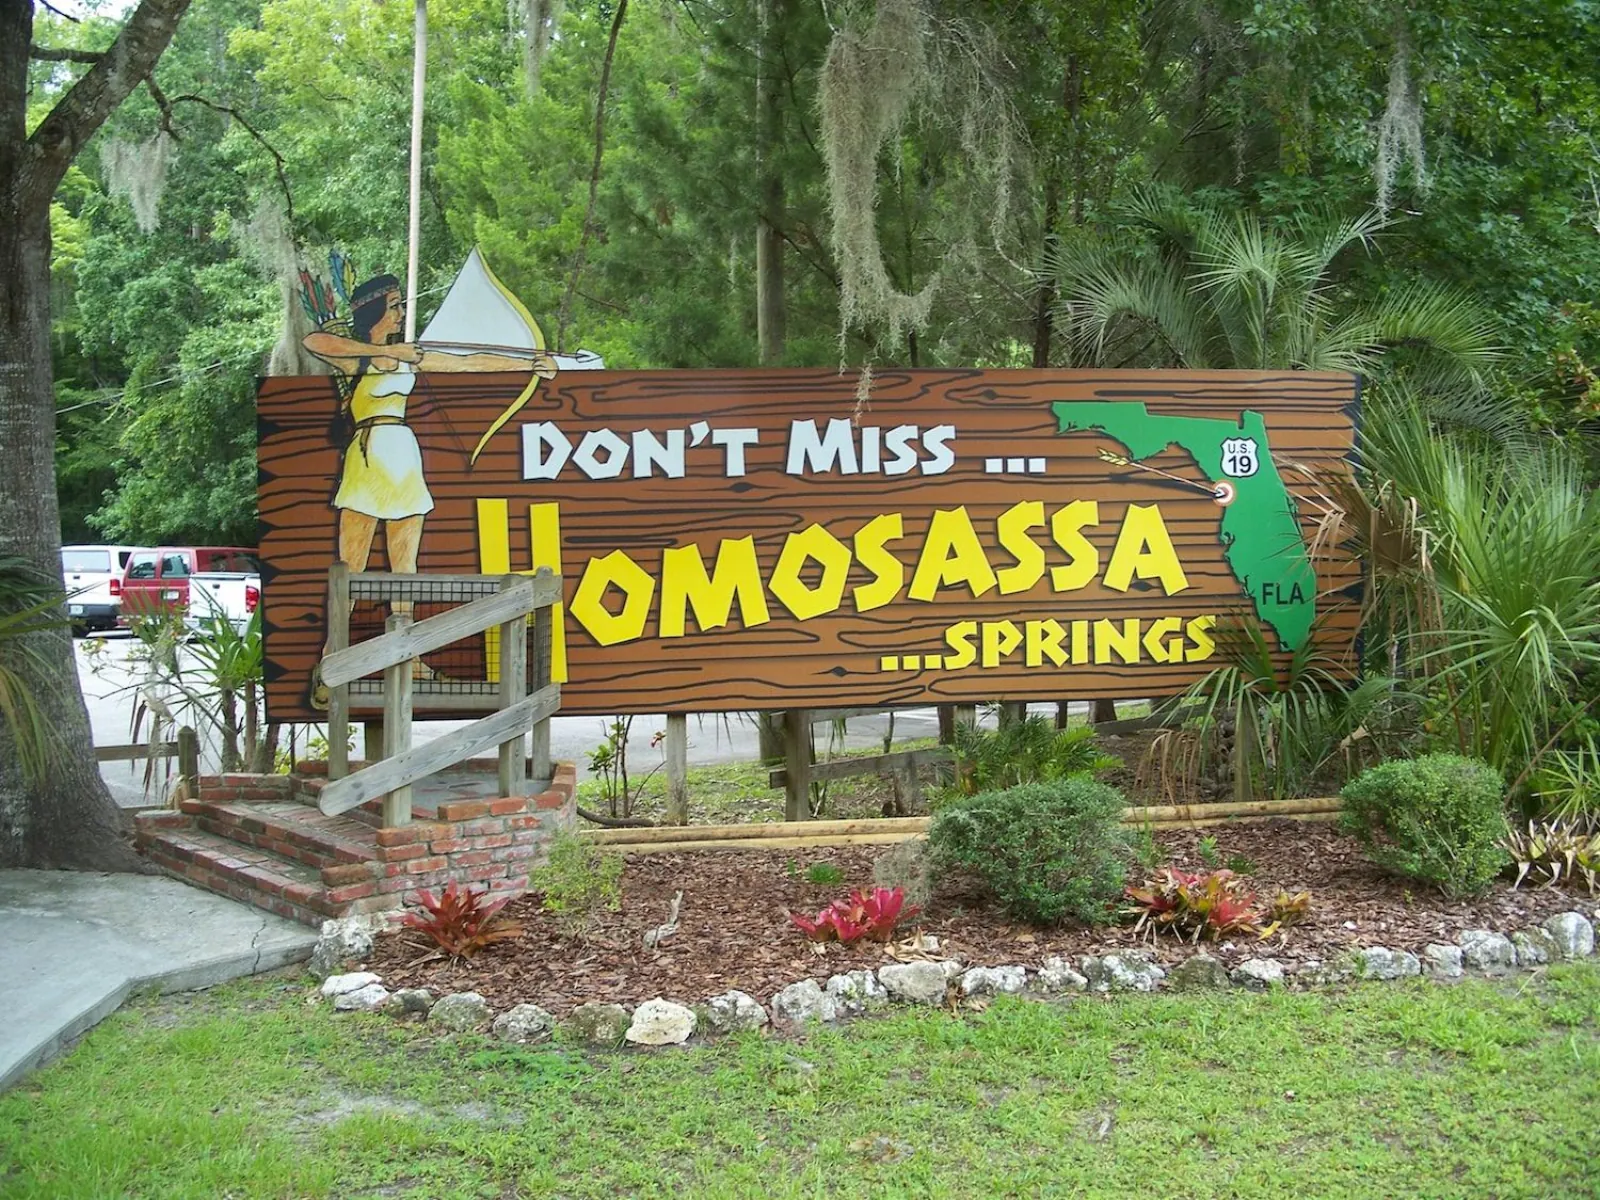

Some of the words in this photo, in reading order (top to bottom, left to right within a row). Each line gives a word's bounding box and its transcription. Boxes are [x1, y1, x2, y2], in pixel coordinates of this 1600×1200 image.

[521, 420, 759, 481] DON'T
[785, 417, 956, 476] MISS
[1228, 443, 1251, 454] U.S.
[1228, 455, 1251, 474] 19
[476, 497, 1189, 683] HOMOSASSA
[1262, 582, 1305, 606] FLA
